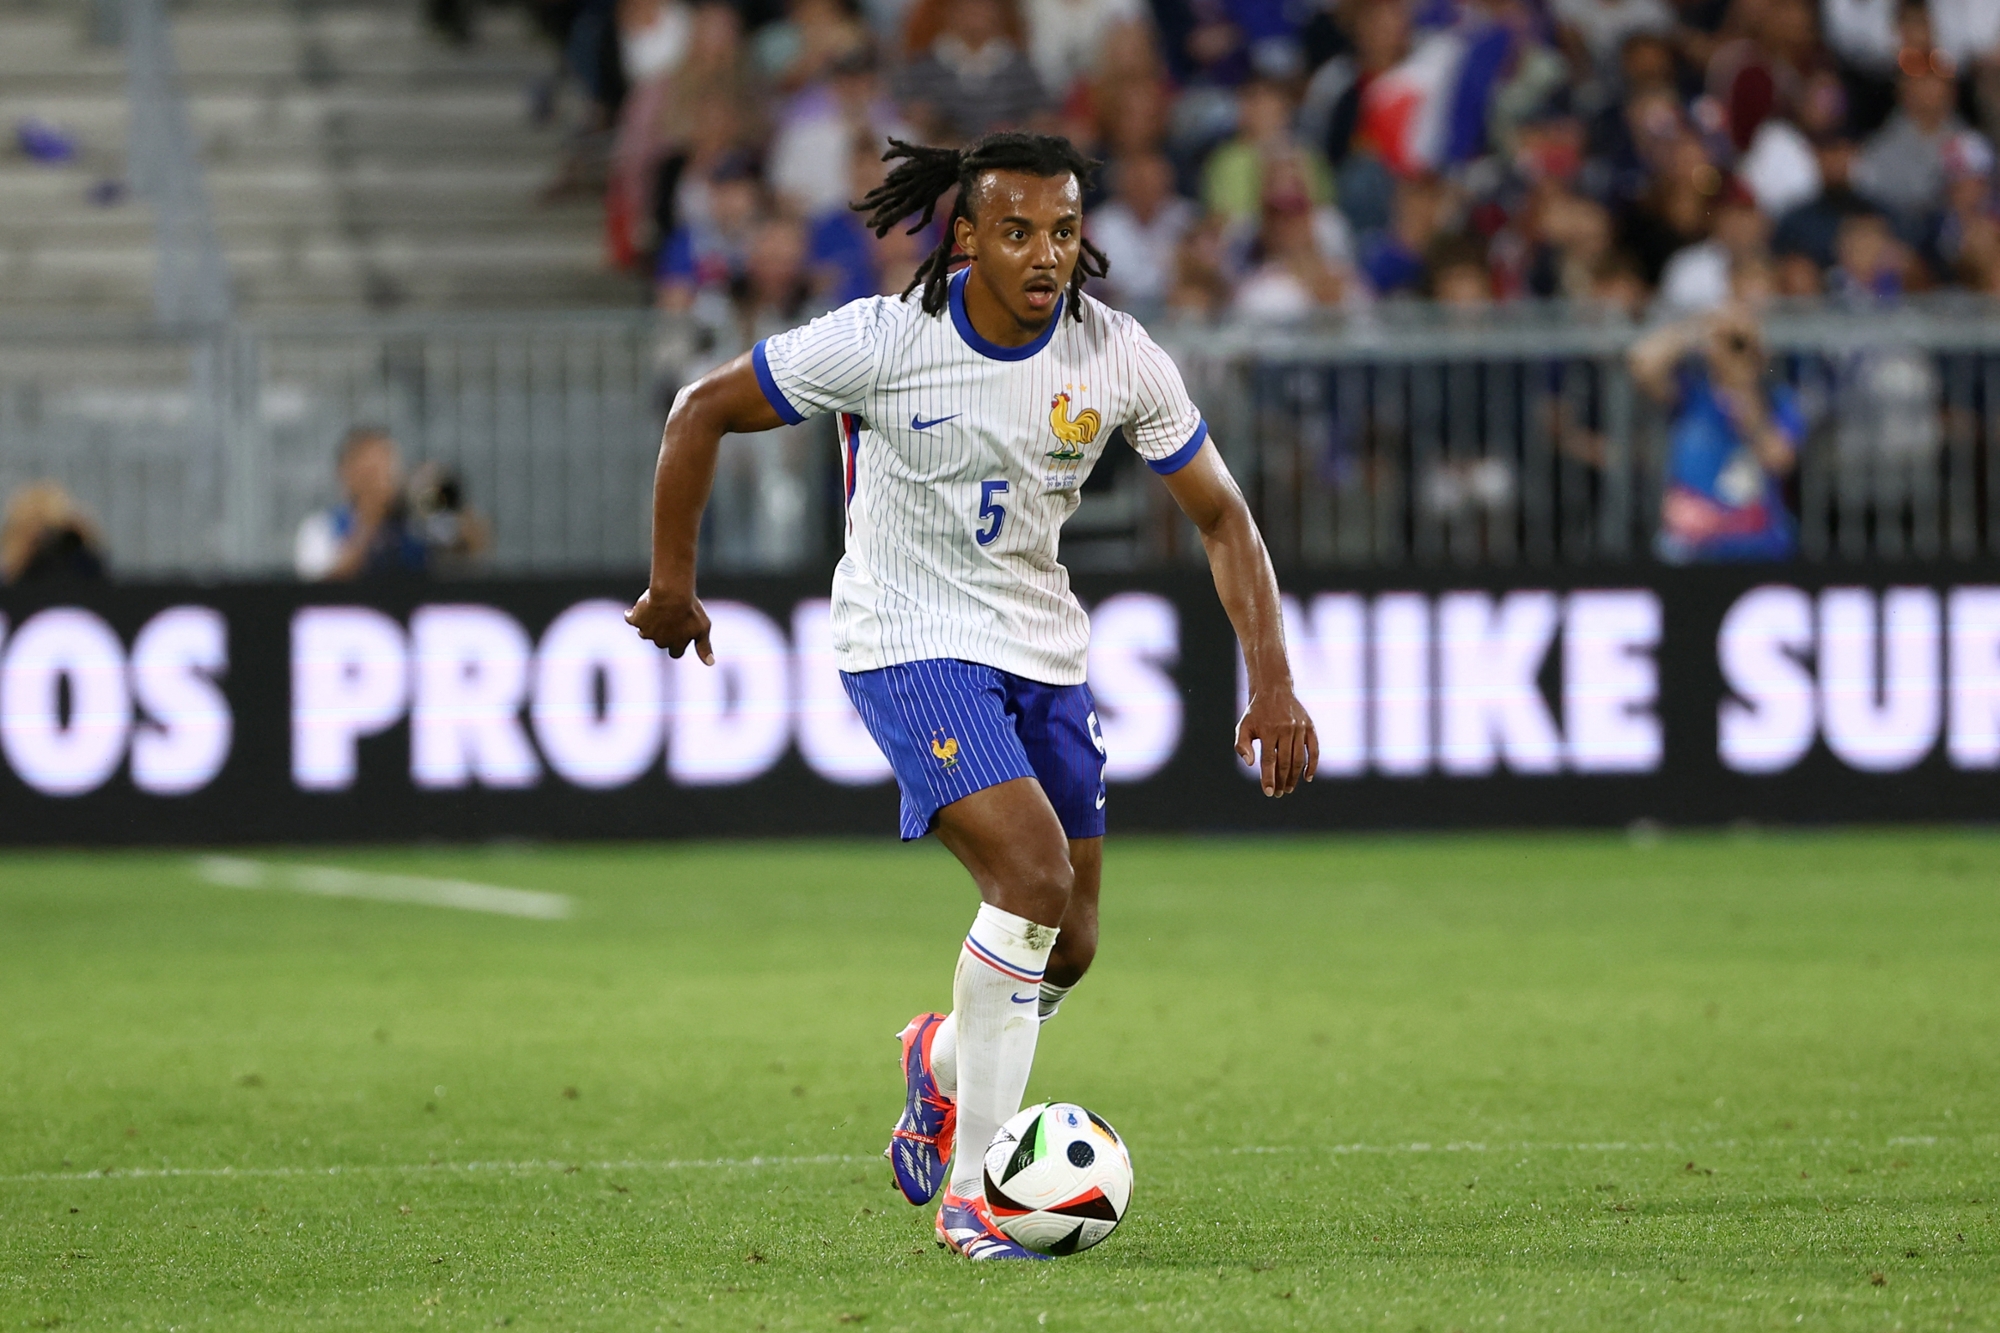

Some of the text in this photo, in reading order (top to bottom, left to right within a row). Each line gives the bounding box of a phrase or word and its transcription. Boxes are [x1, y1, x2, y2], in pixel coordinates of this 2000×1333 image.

[976, 480, 1010, 547] 5
[0, 605, 232, 795] OS
[1236, 590, 1663, 777] NIKE
